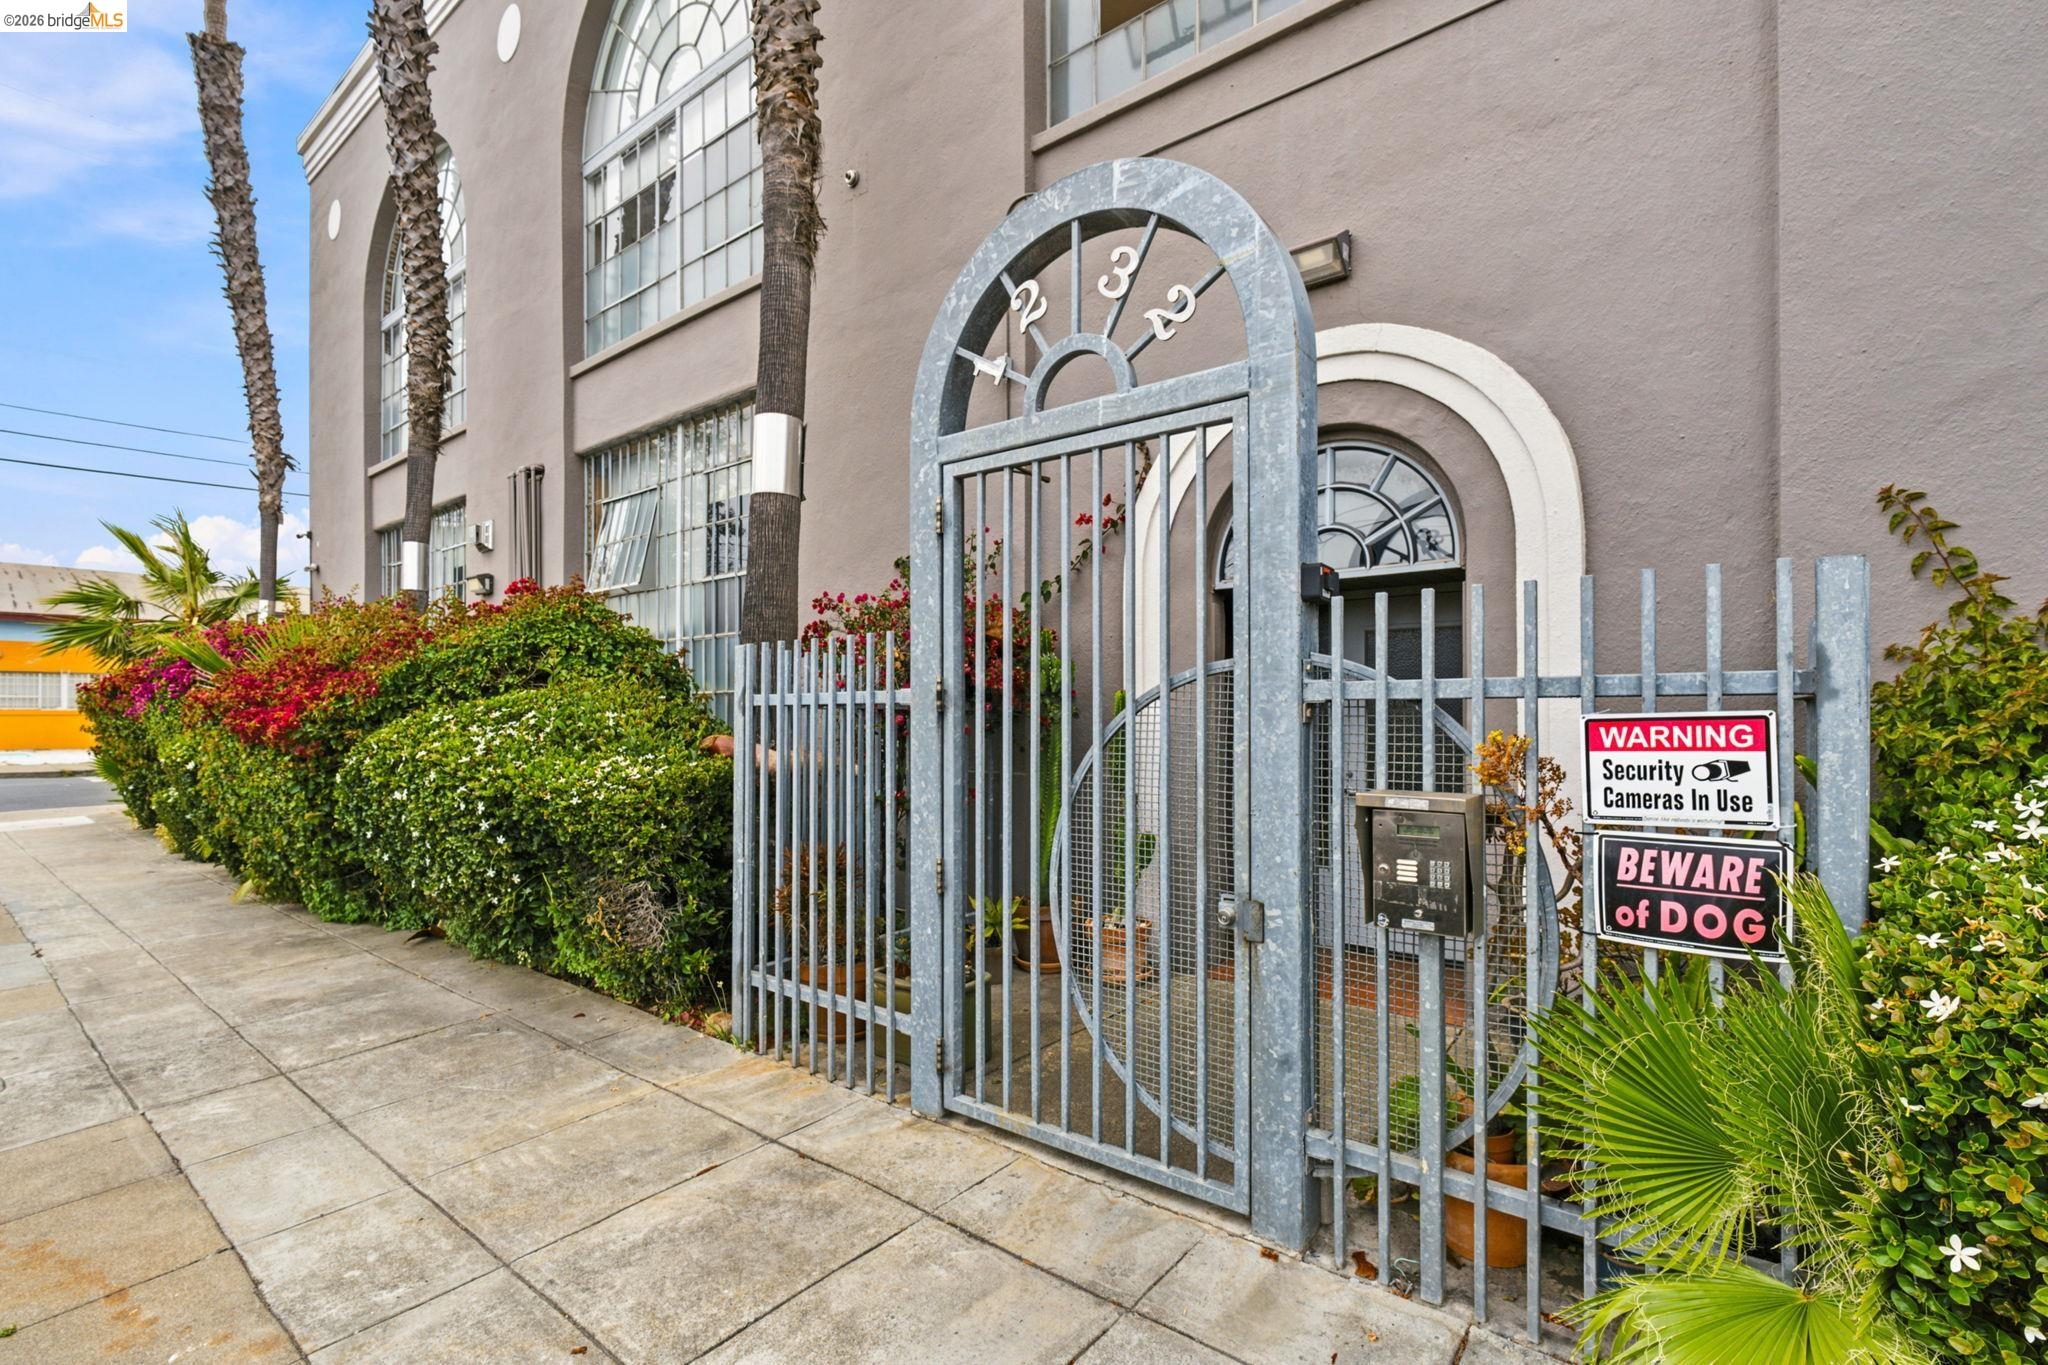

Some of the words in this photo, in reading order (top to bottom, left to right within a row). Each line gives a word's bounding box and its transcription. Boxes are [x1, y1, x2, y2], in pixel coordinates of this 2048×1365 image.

[1598, 723, 1754, 749] WARNING
[1602, 758, 1685, 787] Security
[1603, 786, 1684, 811] Cameras
[1691, 788, 1710, 812] In
[1716, 788, 1754, 813] Use
[1616, 846, 1766, 895] BEWARE
[1615, 898, 1650, 929] of
[1659, 900, 1767, 944] DOG
